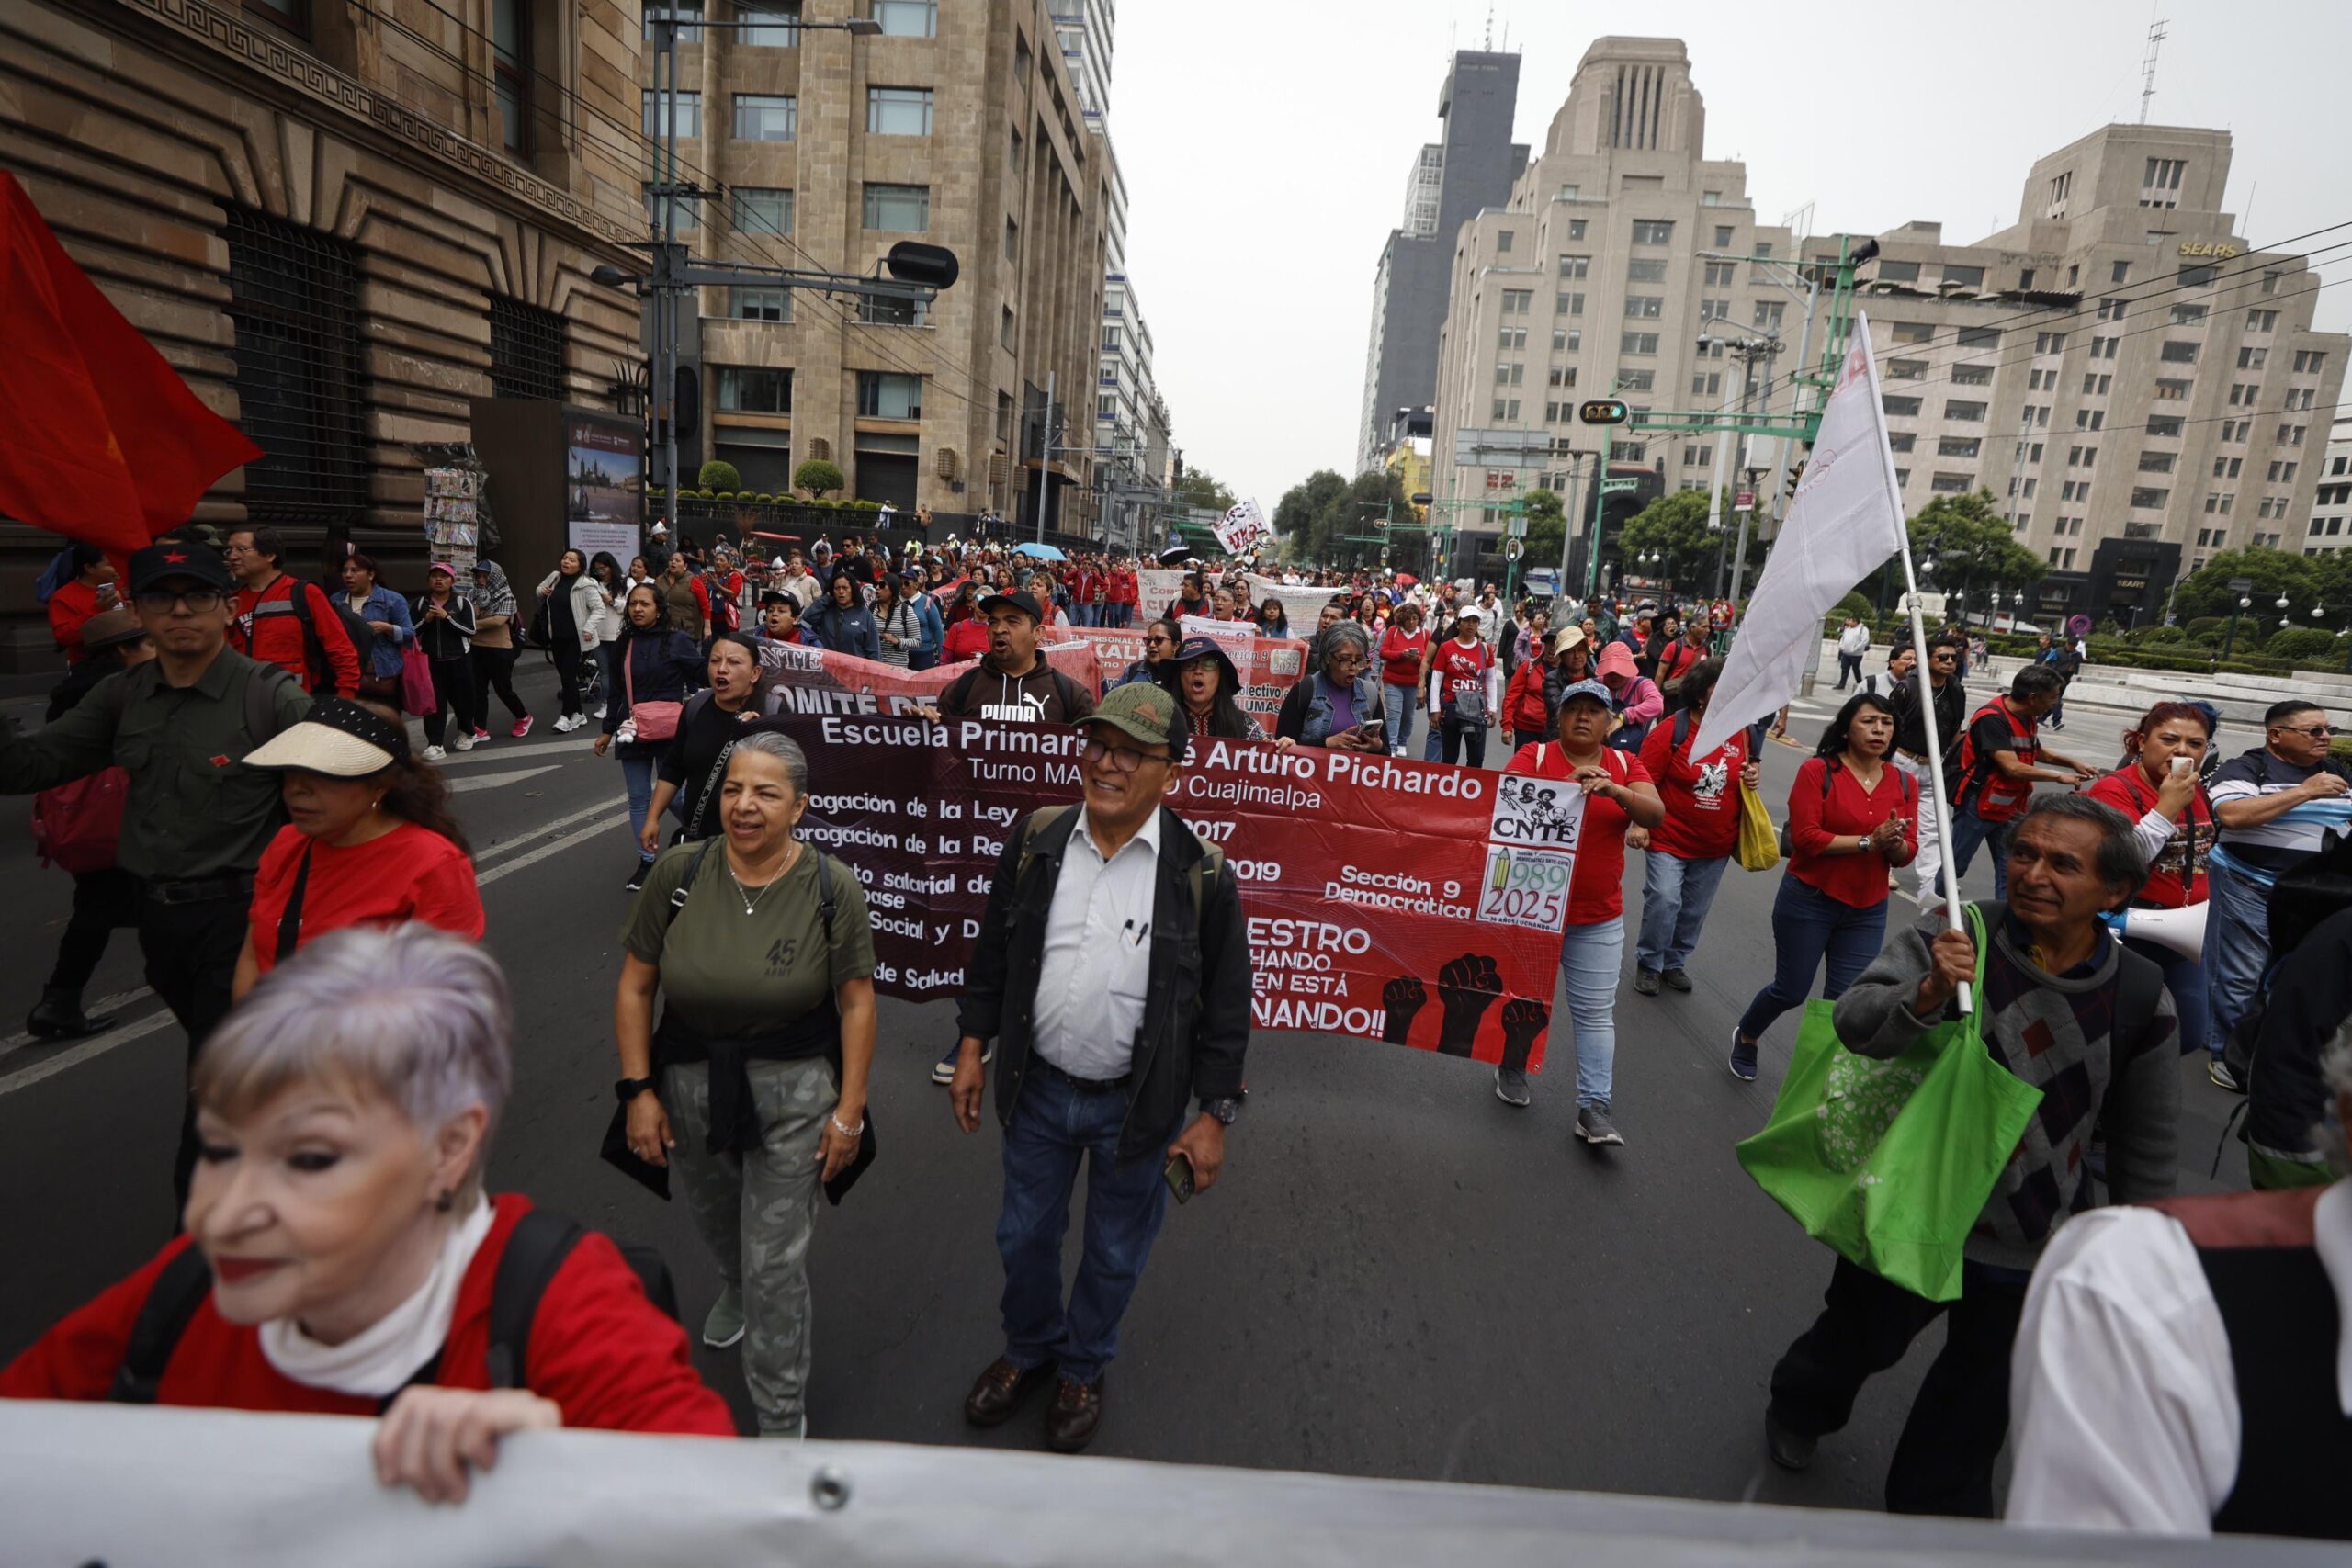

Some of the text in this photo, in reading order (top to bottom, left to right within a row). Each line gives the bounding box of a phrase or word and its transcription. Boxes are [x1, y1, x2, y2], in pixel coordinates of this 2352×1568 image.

[2178, 242, 2237, 257] SEARS
[1084, 635, 1134, 645] PERSONAL
[759, 644, 824, 672] NTE
[1225, 649, 1269, 661] ección 9
[1273, 662, 1298, 674] 2025
[767, 684, 878, 716] OMITÉ
[1239, 682, 1282, 698] olectivo
[980, 704, 1036, 722] PUMA
[821, 716, 949, 748] Escuela
[960, 721, 1089, 757] Primari
[1205, 740, 1316, 779] Arturo
[1327, 753, 1483, 800] Pichardo
[967, 758, 1037, 782] Turno
[1188, 775, 1321, 811] Cuajimalpa
[808, 793, 896, 815] ogación
[906, 796, 928, 818] de
[939, 800, 962, 819] la
[973, 800, 1019, 827] Ley
[1493, 817, 1577, 844] CNTE
[905, 833, 927, 854] de
[939, 836, 961, 854] la
[973, 835, 1004, 857] Re
[883, 873, 956, 895] salarial
[1443, 880, 1461, 899] 9
[1485, 887, 1561, 923] 2025
[868, 910, 924, 941] Social
[933, 923, 951, 946] y
[1247, 917, 1371, 954] ESTRO
[765, 938, 797, 966] 45
[1250, 948, 1331, 972] HANDO
[874, 962, 965, 991] de Salud
[1252, 972, 1348, 997] EN ESTÁ
[1250, 990, 1386, 1037] ÑANDO!!
